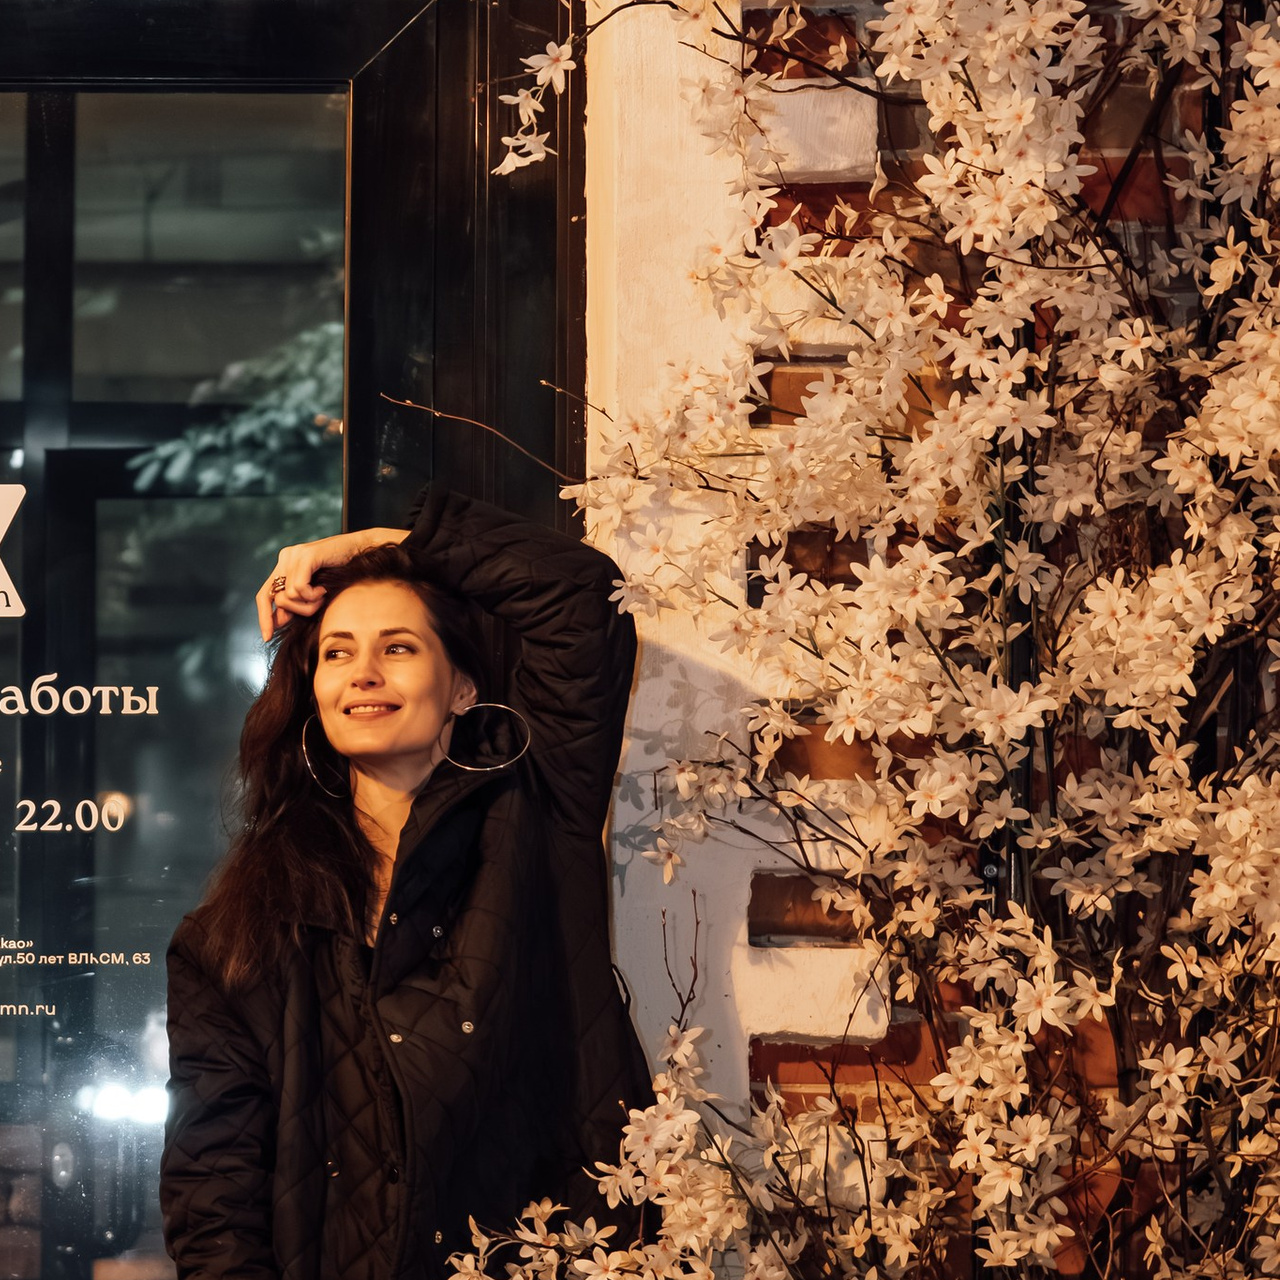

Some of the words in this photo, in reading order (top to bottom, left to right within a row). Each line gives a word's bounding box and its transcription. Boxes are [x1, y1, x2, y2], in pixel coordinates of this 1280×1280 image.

[15, 799, 125, 832] 22.00
[38, 955, 65, 964] лет
[132, 952, 151, 964] 63
